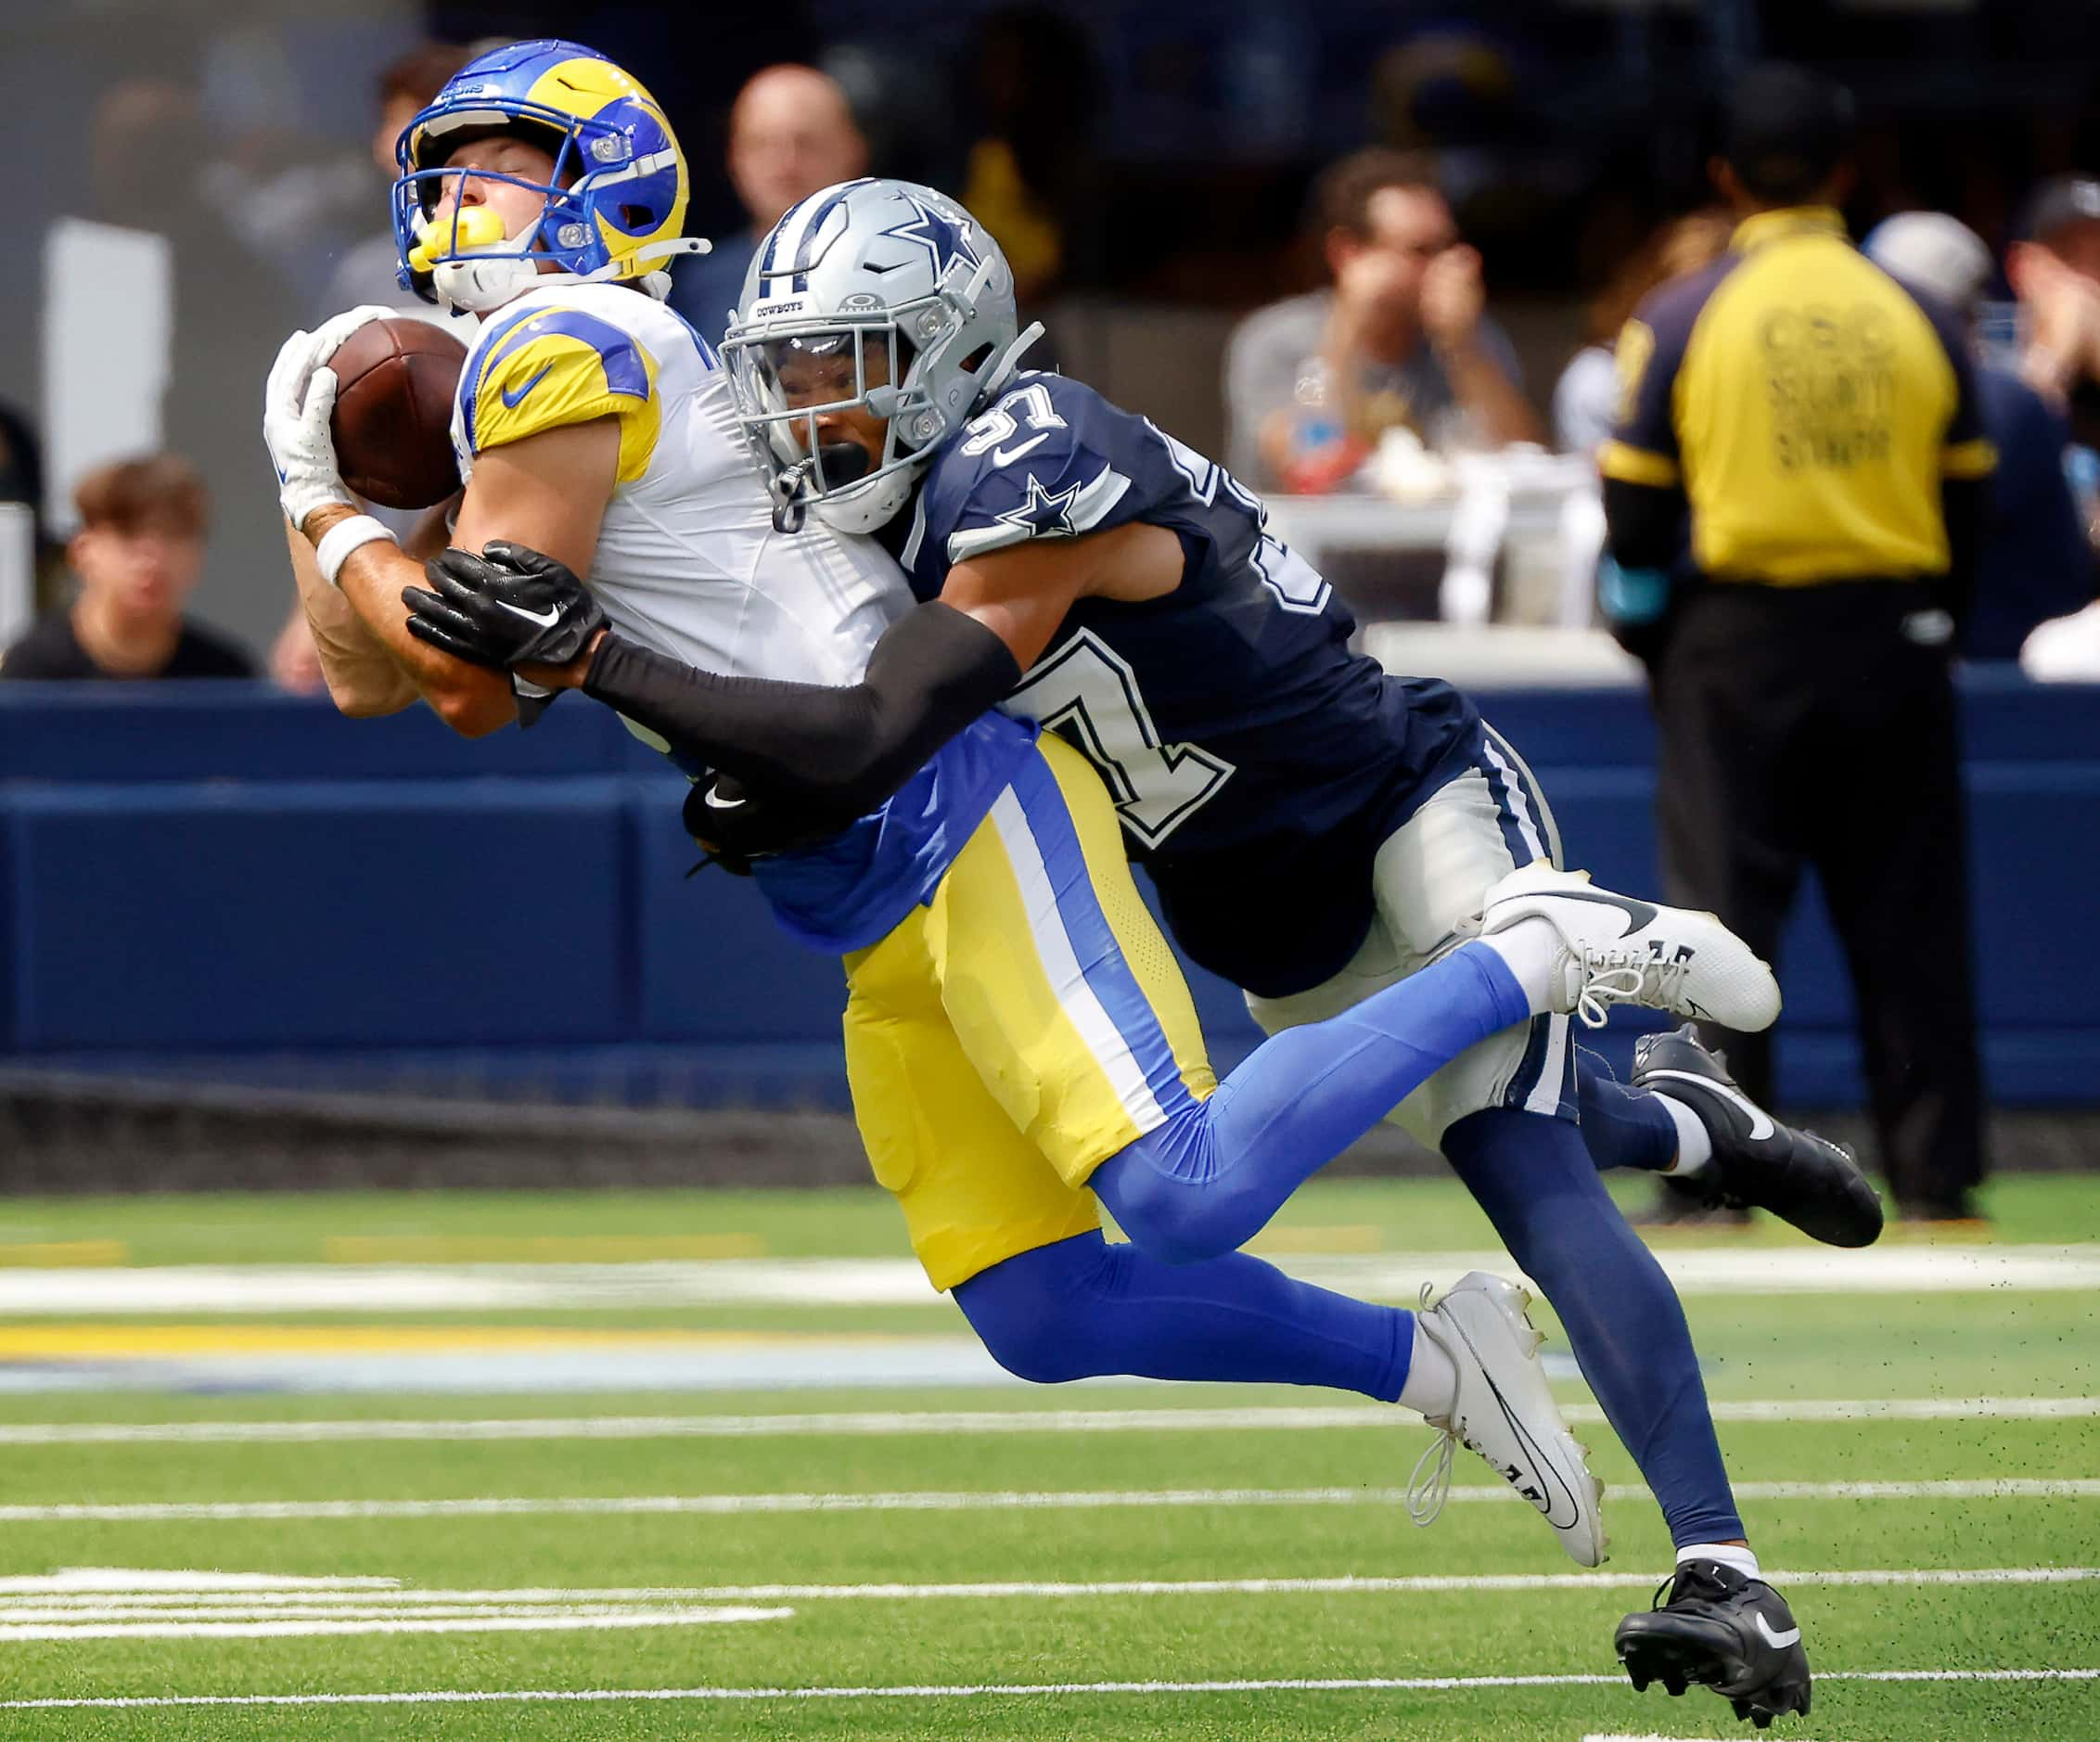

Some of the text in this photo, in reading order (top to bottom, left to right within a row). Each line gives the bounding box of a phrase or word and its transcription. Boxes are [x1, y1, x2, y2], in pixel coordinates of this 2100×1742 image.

[757, 301, 803, 317] COWBOYS
[960, 382, 1069, 457] 57
[995, 625, 1237, 851] 7
